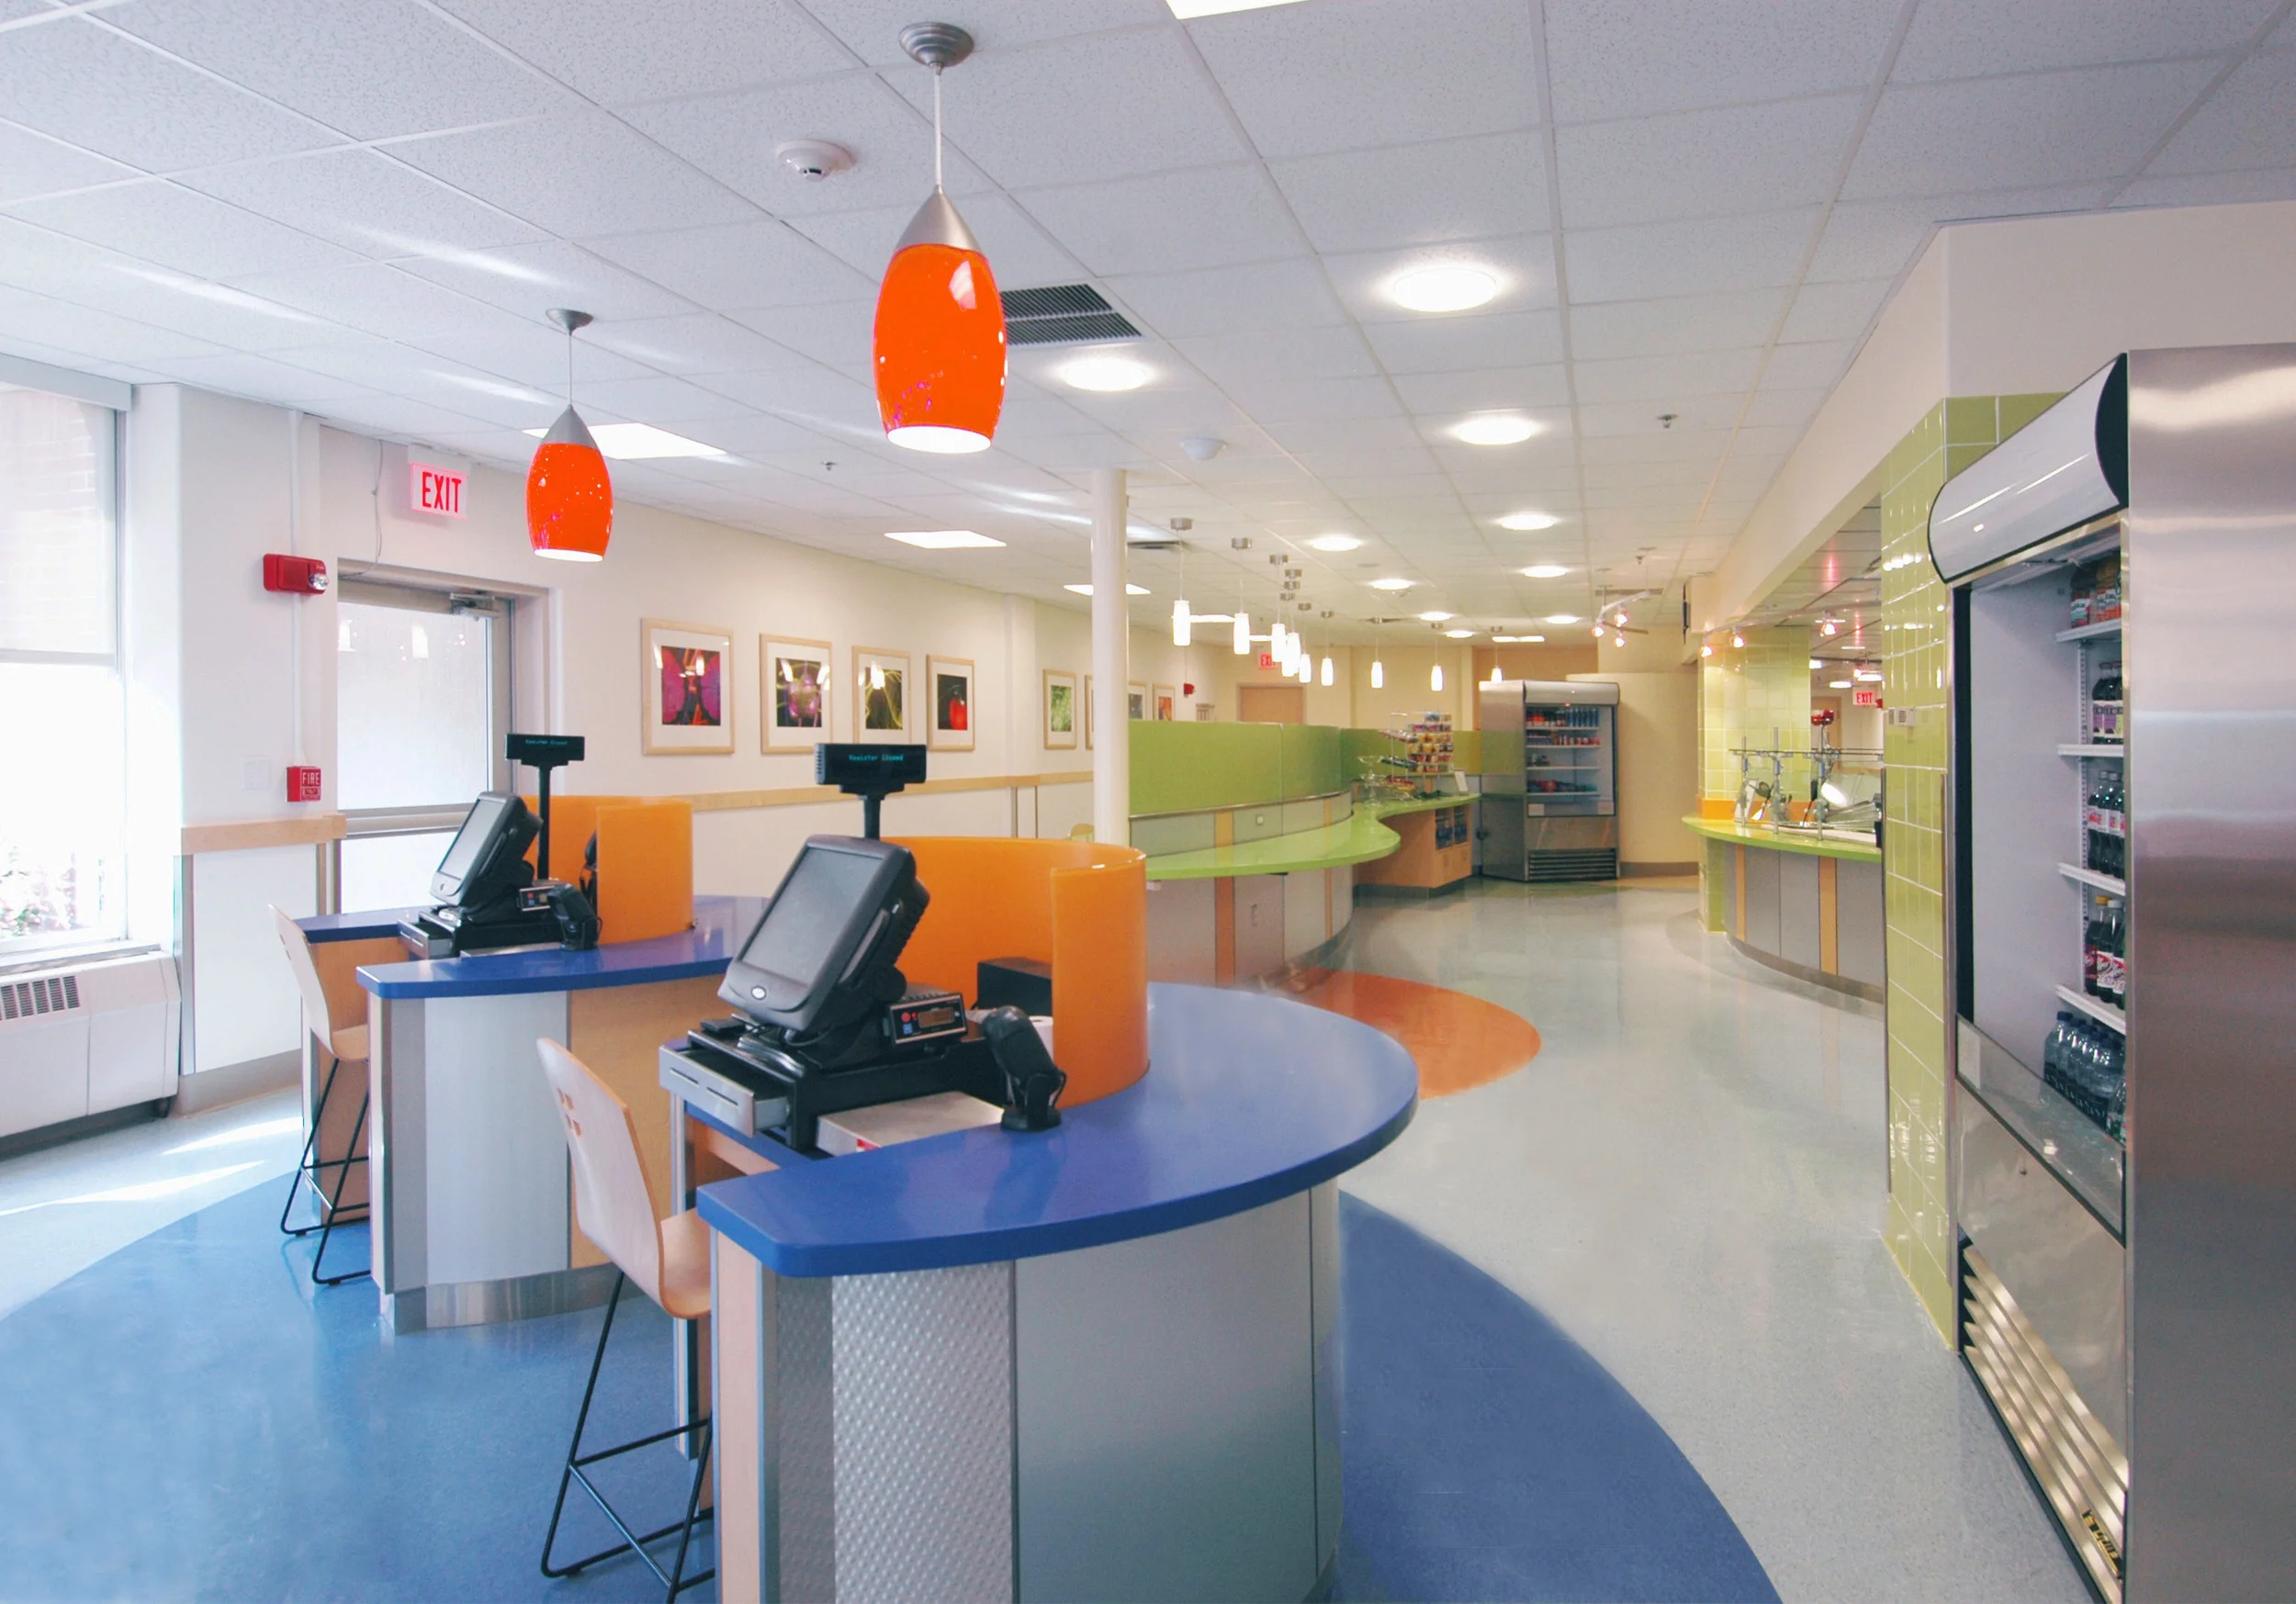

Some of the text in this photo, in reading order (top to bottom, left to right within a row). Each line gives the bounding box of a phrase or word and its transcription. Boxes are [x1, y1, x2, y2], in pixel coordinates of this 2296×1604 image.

[422, 471, 462, 513] EXIT
[1856, 692, 1874, 704] EXIT
[303, 772, 321, 785] FIRE
